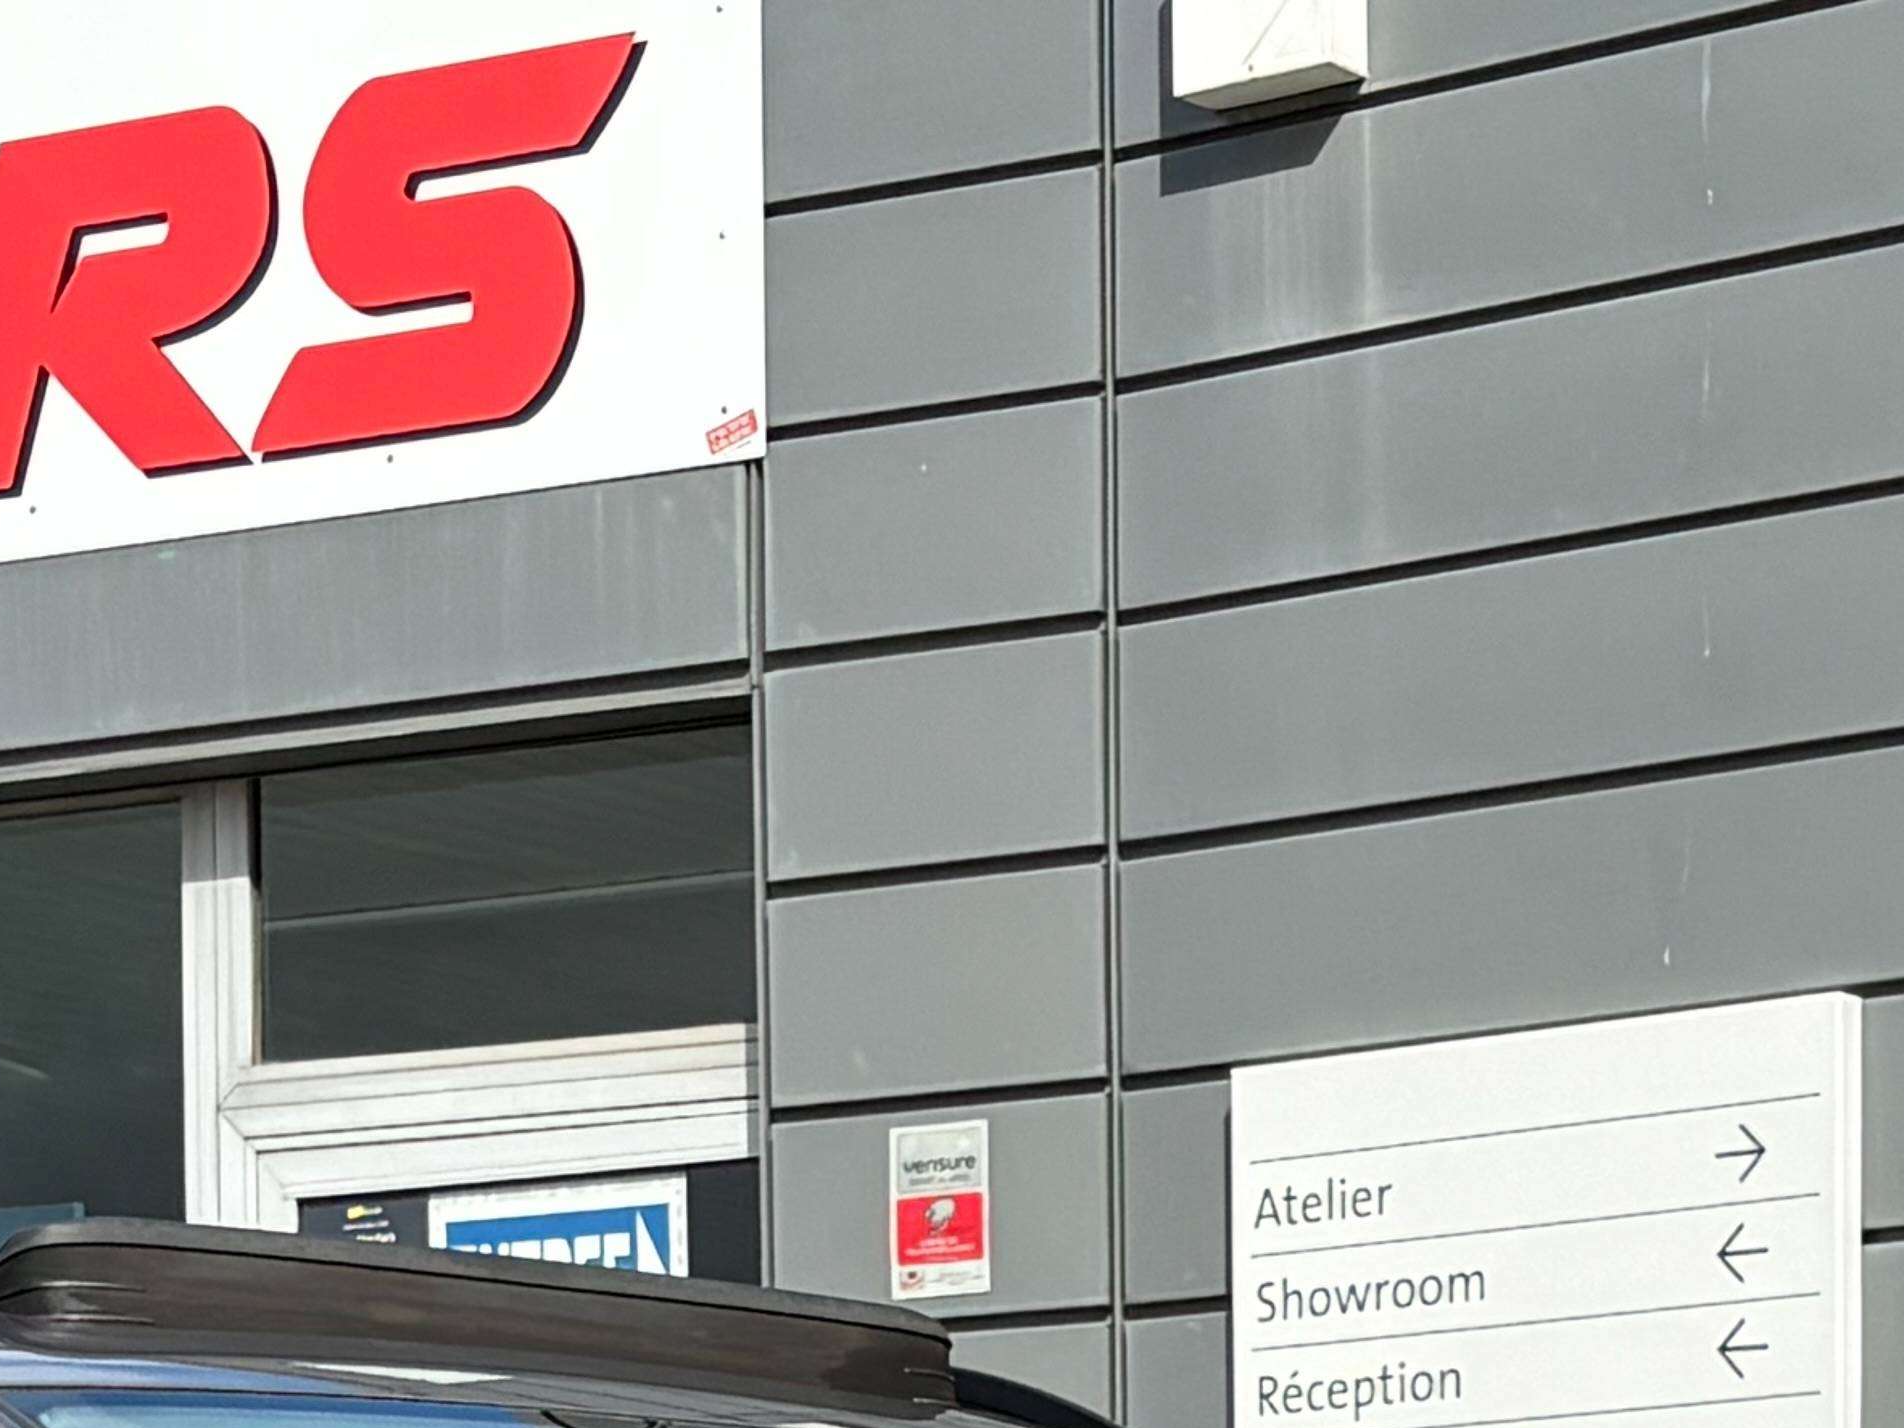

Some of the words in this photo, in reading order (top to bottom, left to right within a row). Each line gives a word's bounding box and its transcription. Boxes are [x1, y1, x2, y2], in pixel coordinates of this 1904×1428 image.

[1254, 1177, 1392, 1229] Atelier
[1256, 1267, 1486, 1323] Showroom
[1257, 1360, 1463, 1421] Réception
